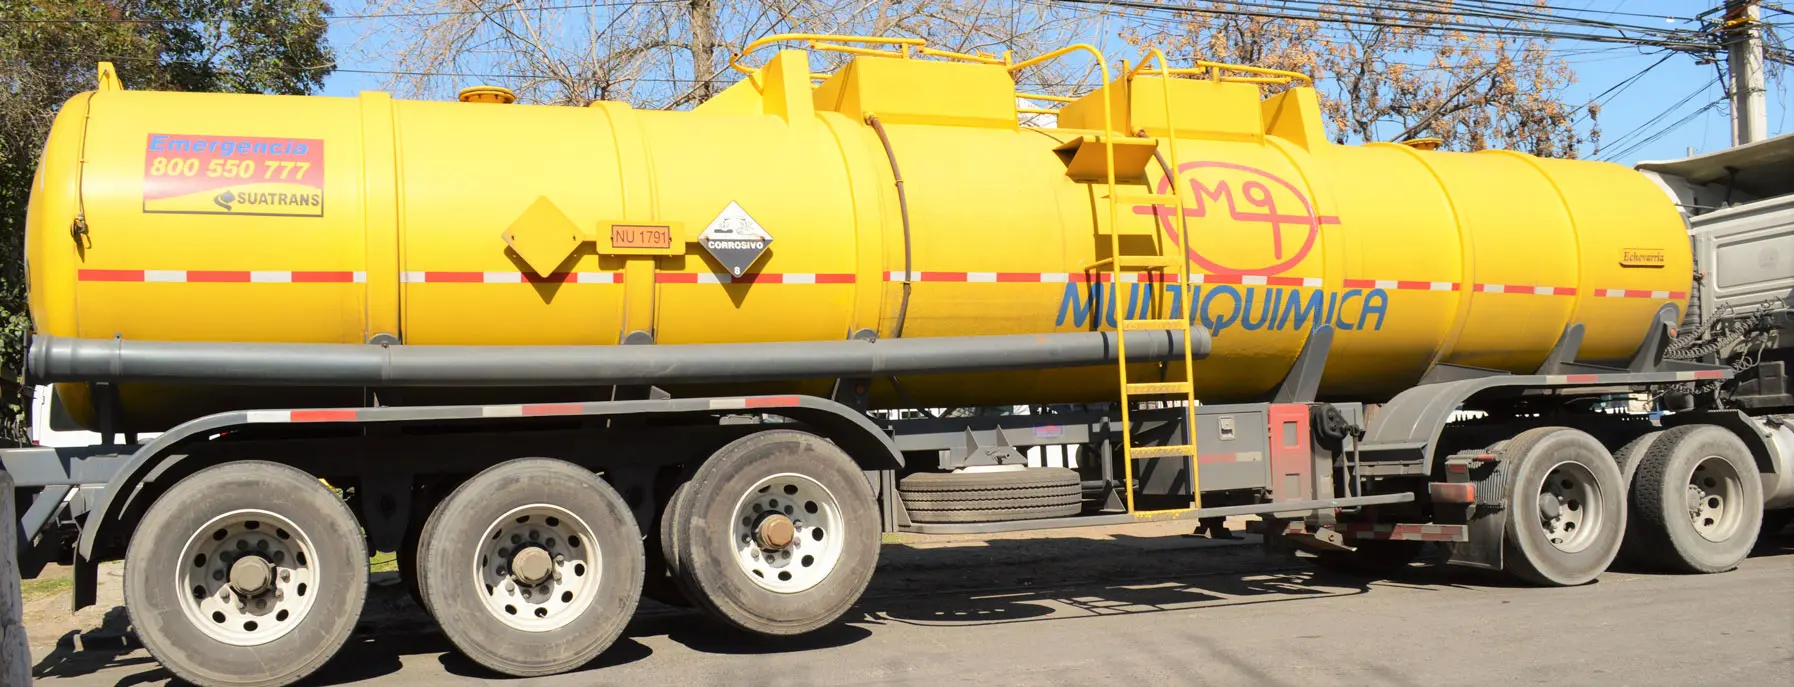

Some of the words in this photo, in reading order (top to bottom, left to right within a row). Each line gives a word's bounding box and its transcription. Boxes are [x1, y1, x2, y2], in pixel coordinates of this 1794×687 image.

[150, 135, 308, 157] Emergencia
[151, 157, 199, 176] 800
[206, 159, 255, 178] 550
[264, 161, 310, 180] 777
[237, 192, 320, 206] SUATRANS
[616, 230, 635, 243] NU
[639, 230, 666, 244] 1791
[708, 241, 763, 249] CORROSIVO
[734, 266, 741, 275] 8
